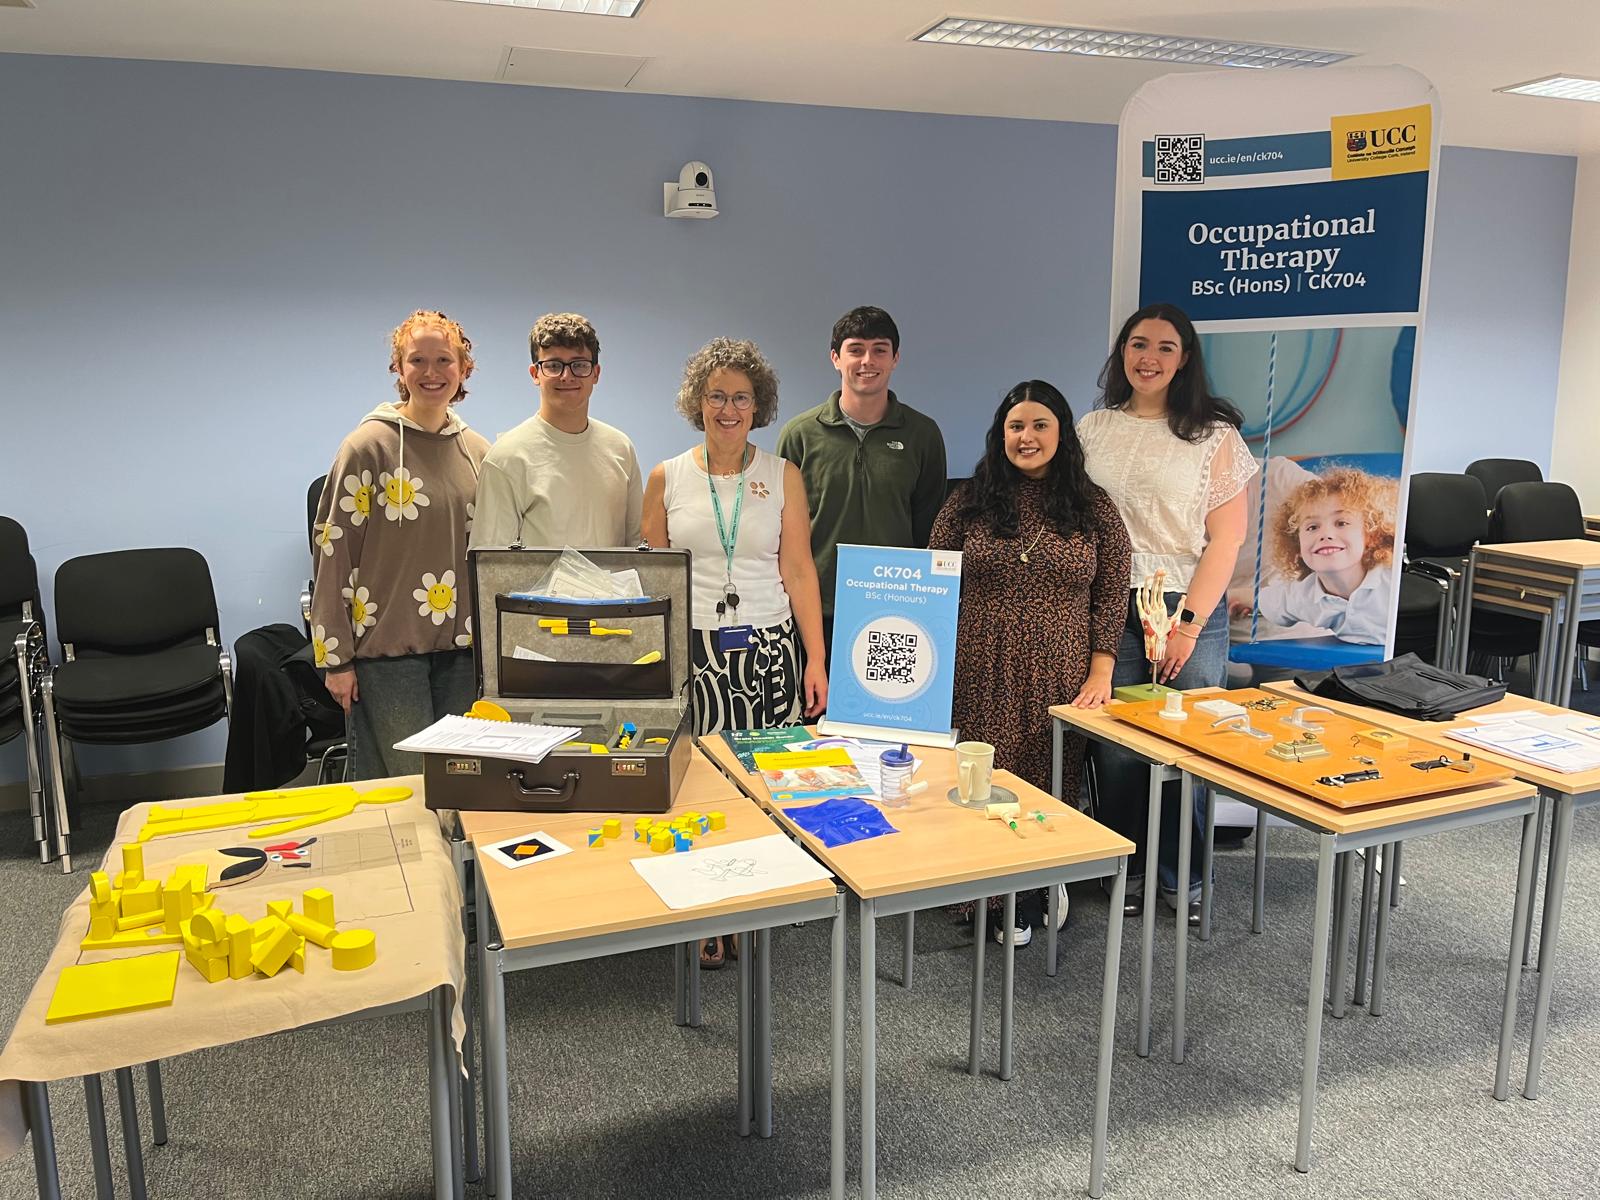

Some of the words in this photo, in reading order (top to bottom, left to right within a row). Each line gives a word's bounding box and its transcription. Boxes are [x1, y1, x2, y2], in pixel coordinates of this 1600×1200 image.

[1369, 124, 1416, 147] UCC
[1209, 151, 1283, 165] ucc.ie/en/ck704
[1188, 208, 1376, 248] Occupational
[1220, 246, 1341, 273] Therapy
[1191, 279, 1224, 296] BSc
[1228, 273, 1291, 298] (Hons)
[1308, 272, 1367, 291] CK704
[873, 565, 923, 581] CK704
[846, 578, 908, 592] Occupational
[909, 583, 950, 596] Therapy
[864, 591, 882, 600] BSc
[883, 593, 928, 605] (Honours)
